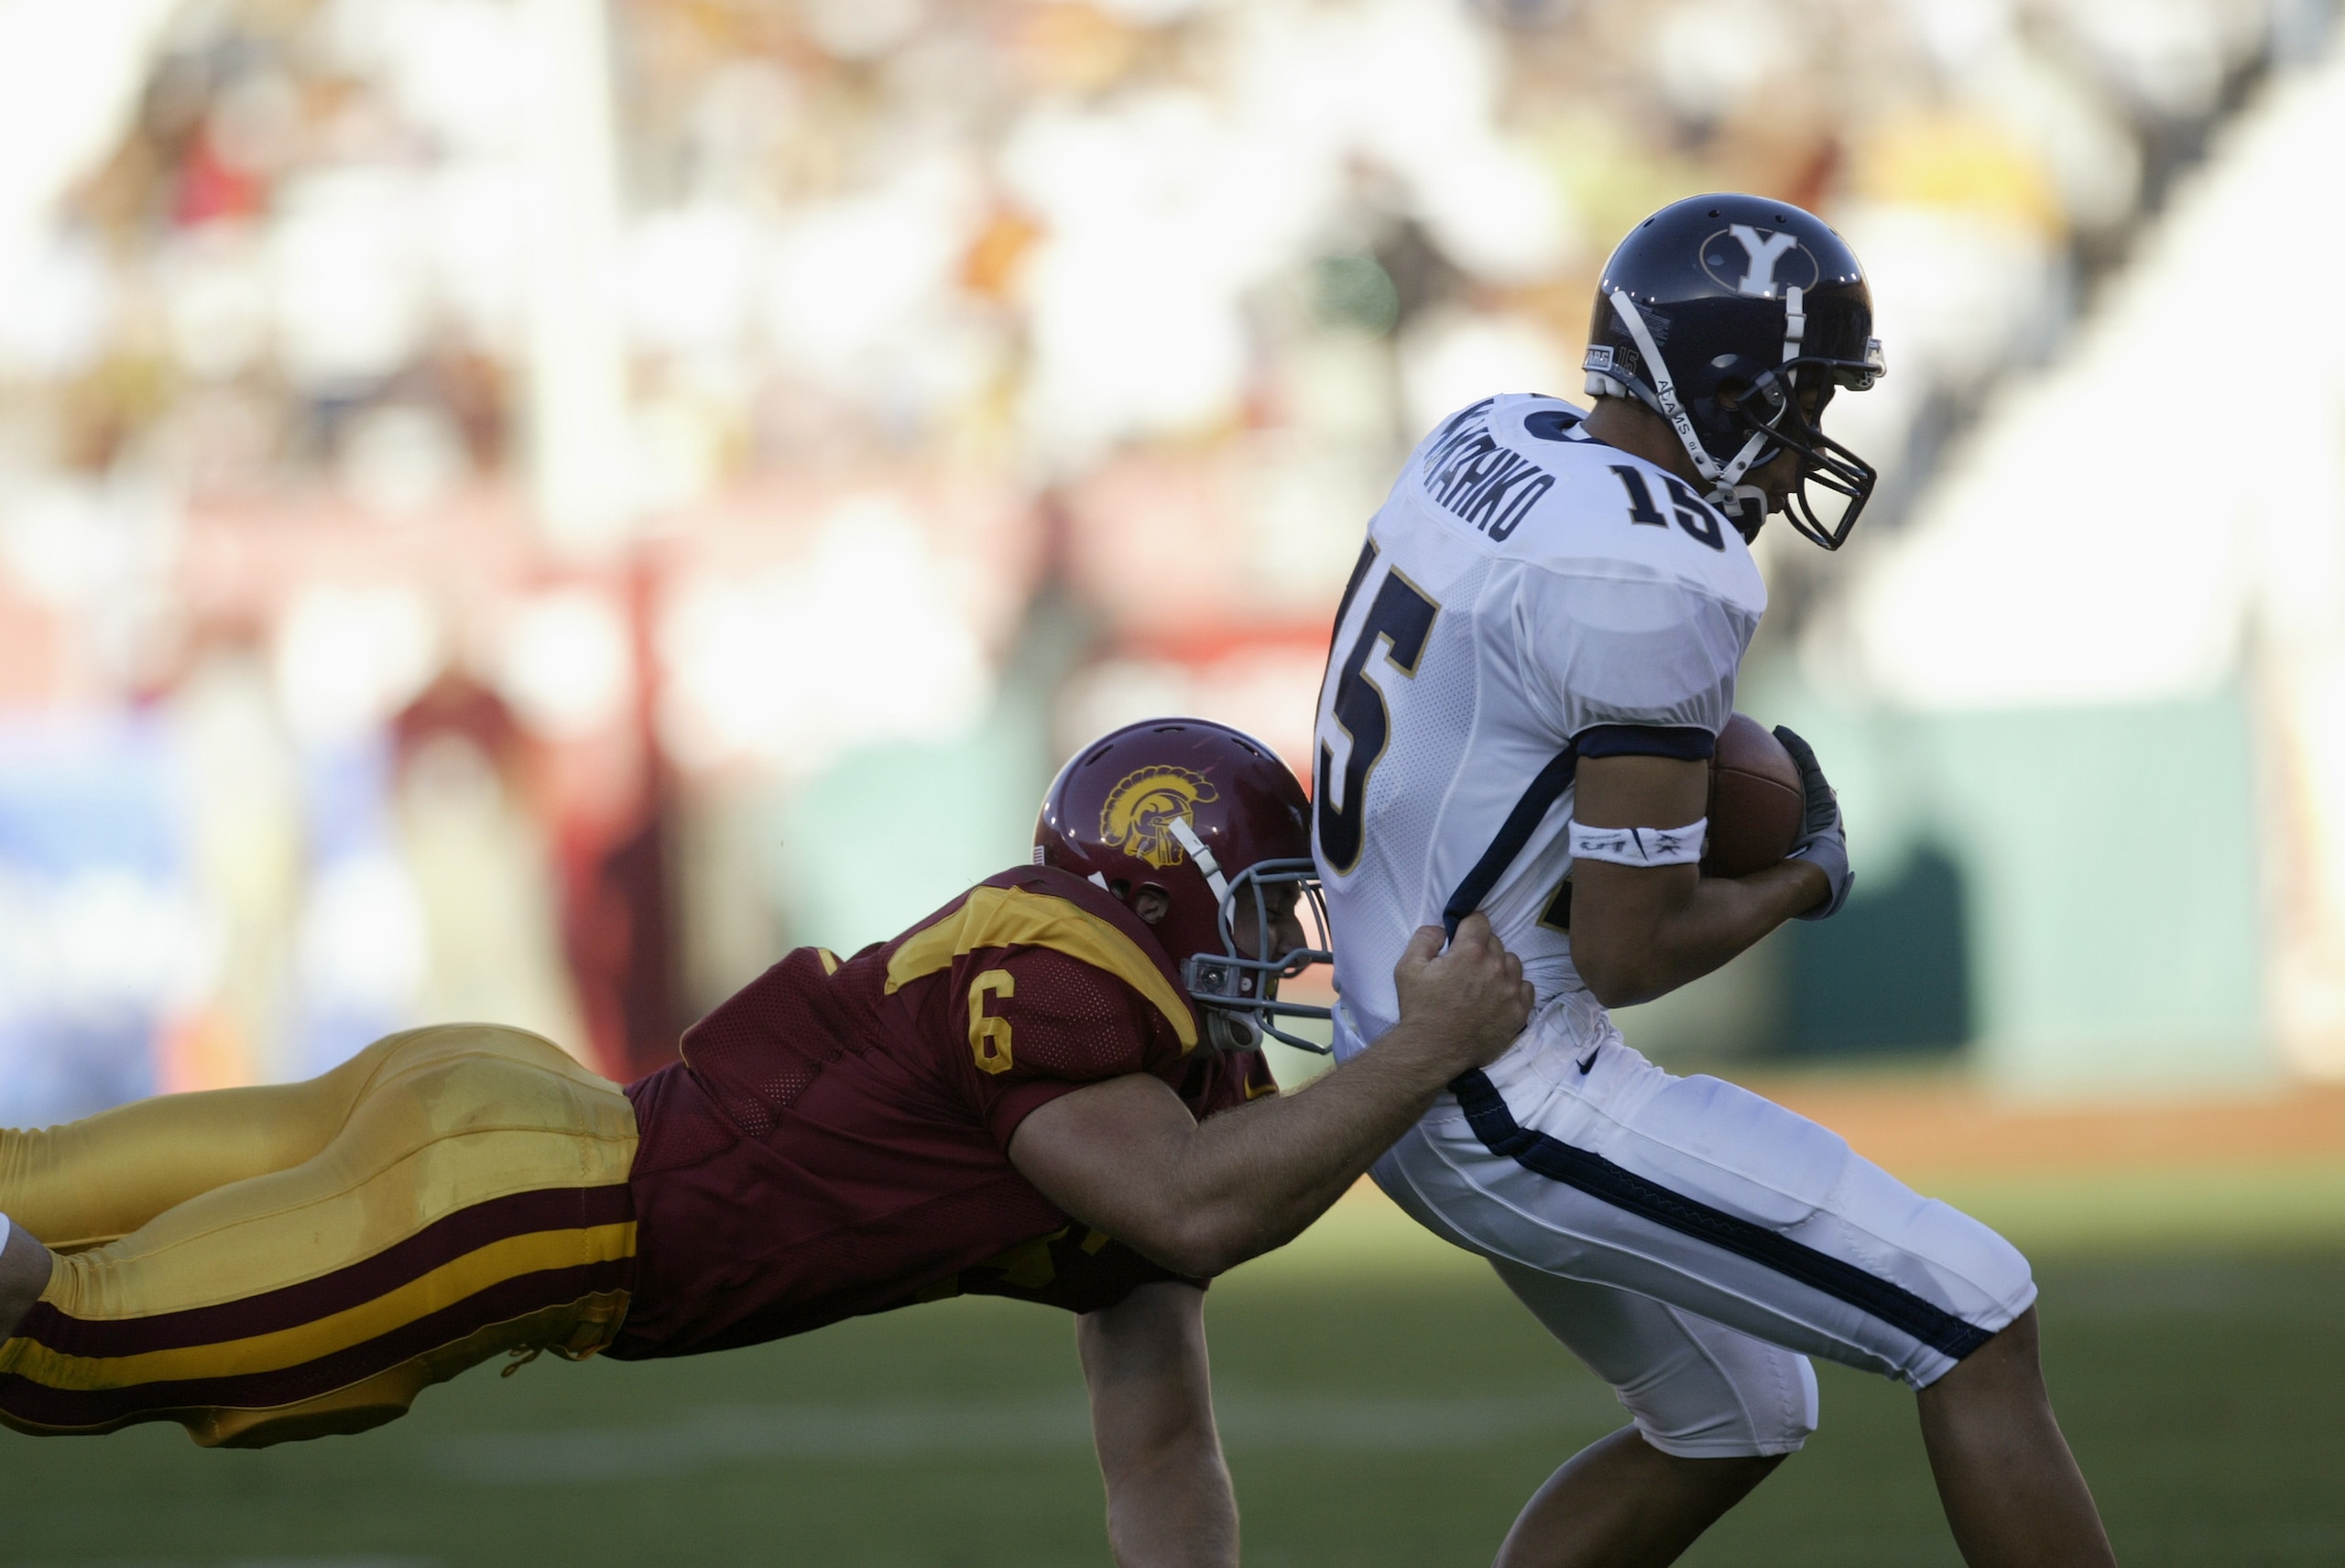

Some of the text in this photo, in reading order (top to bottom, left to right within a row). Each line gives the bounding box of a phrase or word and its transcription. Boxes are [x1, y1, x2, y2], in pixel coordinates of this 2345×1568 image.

[1729, 223, 1797, 300] Y
[1606, 465, 1726, 553] 15
[968, 969, 1015, 1075] 6
